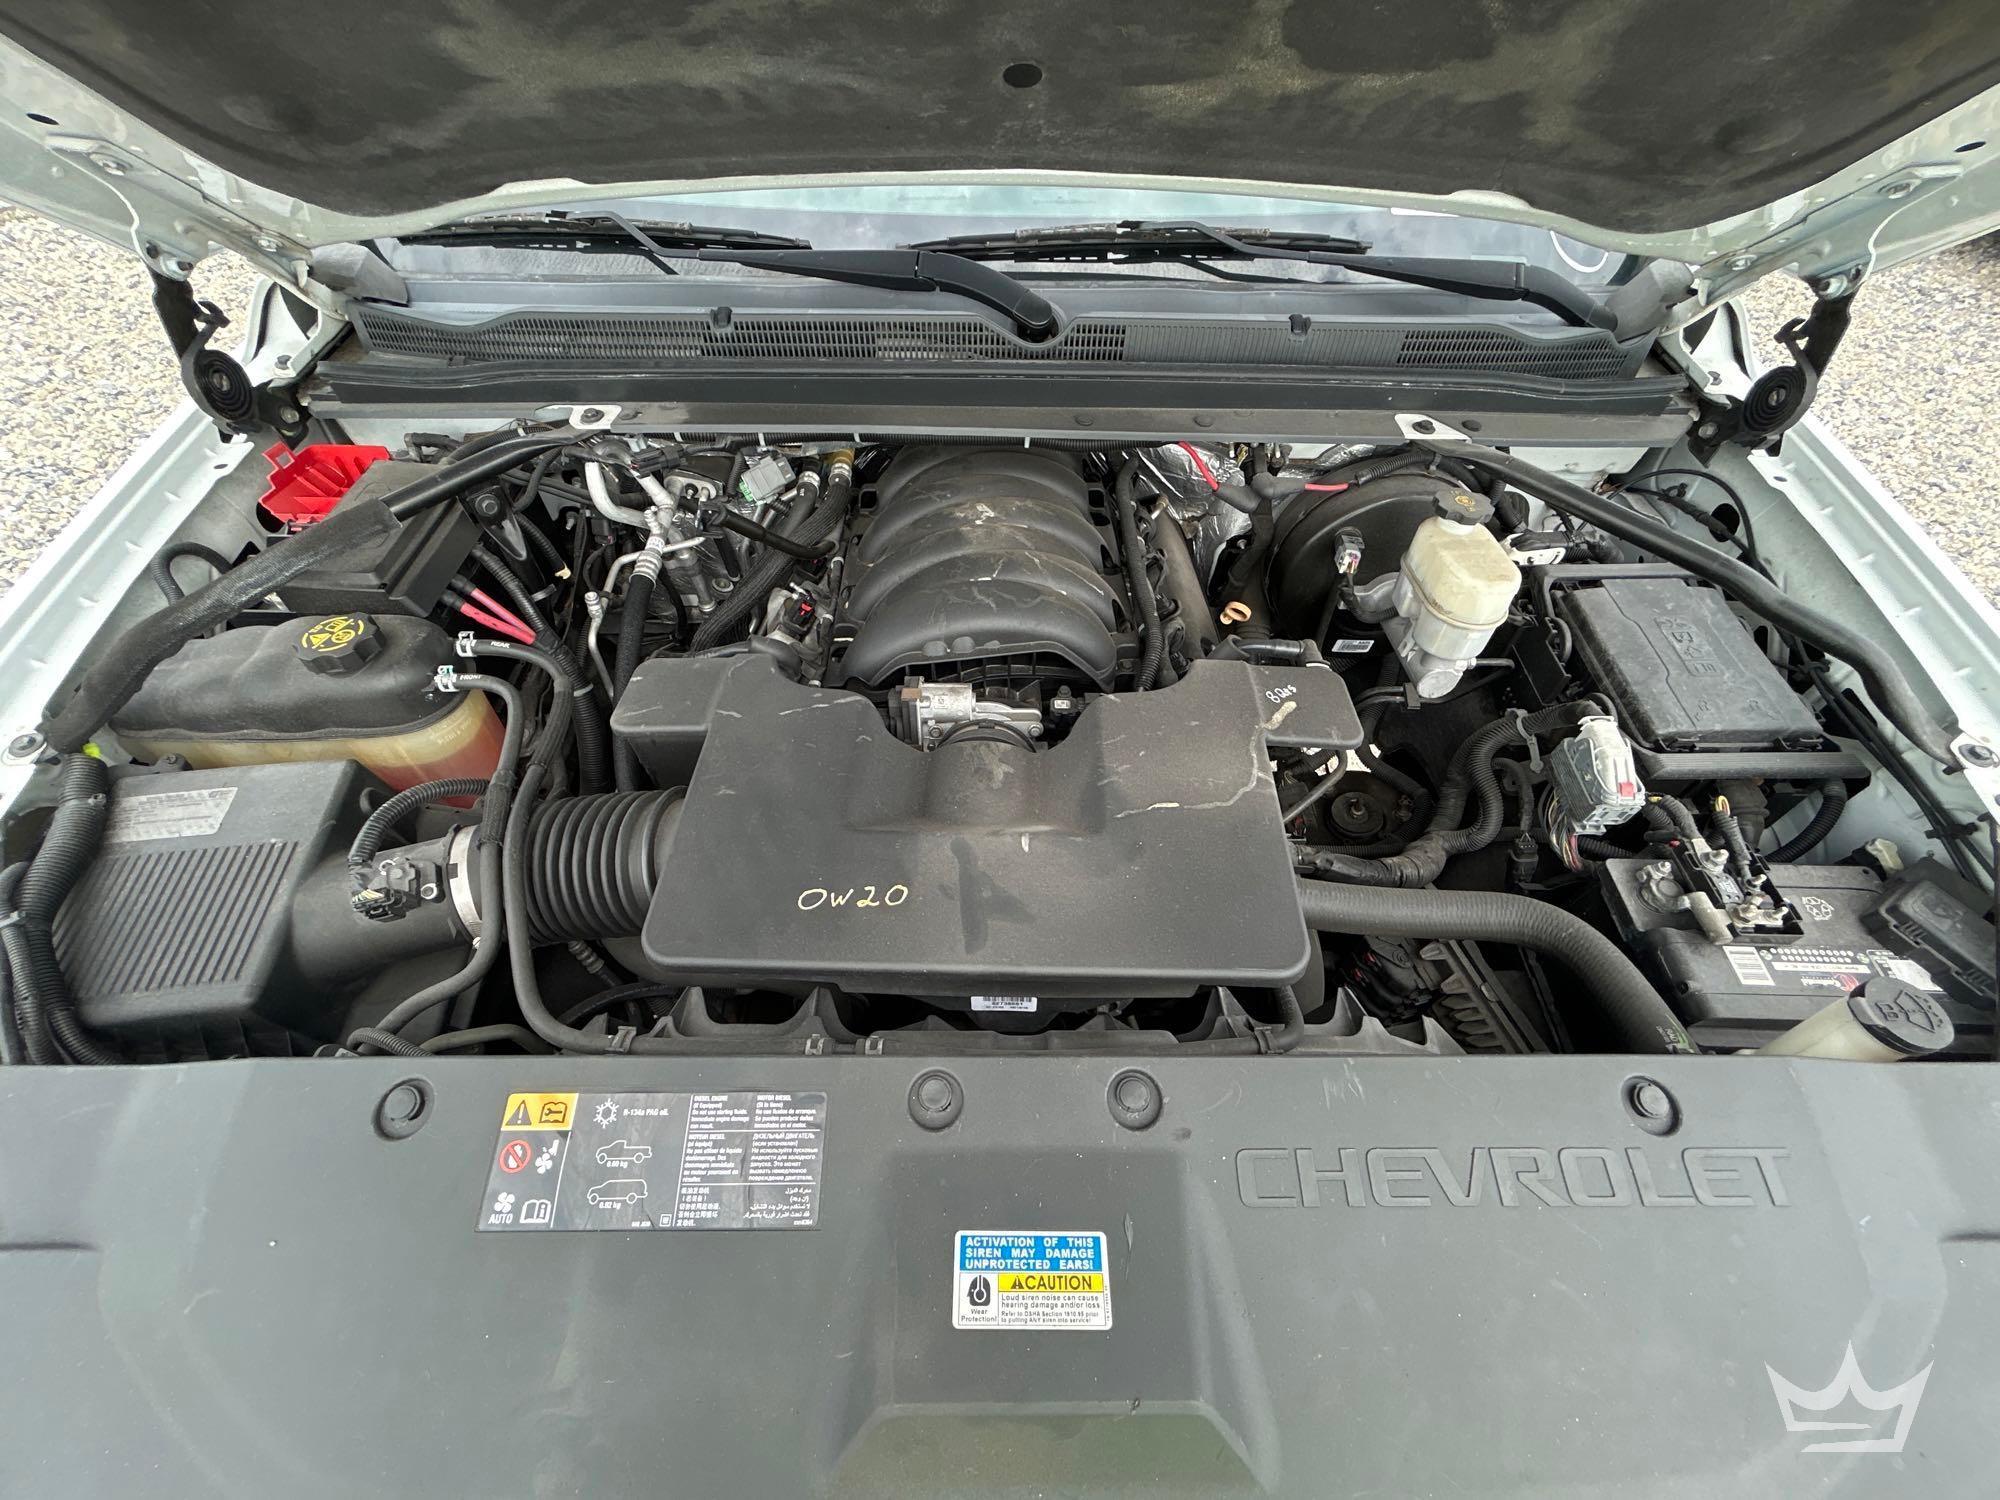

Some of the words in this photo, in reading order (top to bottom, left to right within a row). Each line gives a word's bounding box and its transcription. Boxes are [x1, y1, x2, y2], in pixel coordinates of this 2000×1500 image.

[1236, 1147, 1793, 1208] CHEVROLET
[488, 1213, 513, 1224] AUTO
[965, 1237, 1035, 1247] ACTIVATION
[1043, 1238, 1058, 1247] OF
[1067, 1238, 1094, 1247] THIS
[965, 1248, 1001, 1258] SIREN
[1011, 1248, 1035, 1258] MAY
[1046, 1248, 1094, 1258] DAMAGE
[965, 1259, 1050, 1269] UNPROTECTED
[1060, 1260, 1094, 1269] EARS!
[1025, 1275, 1092, 1290] CAUTION
